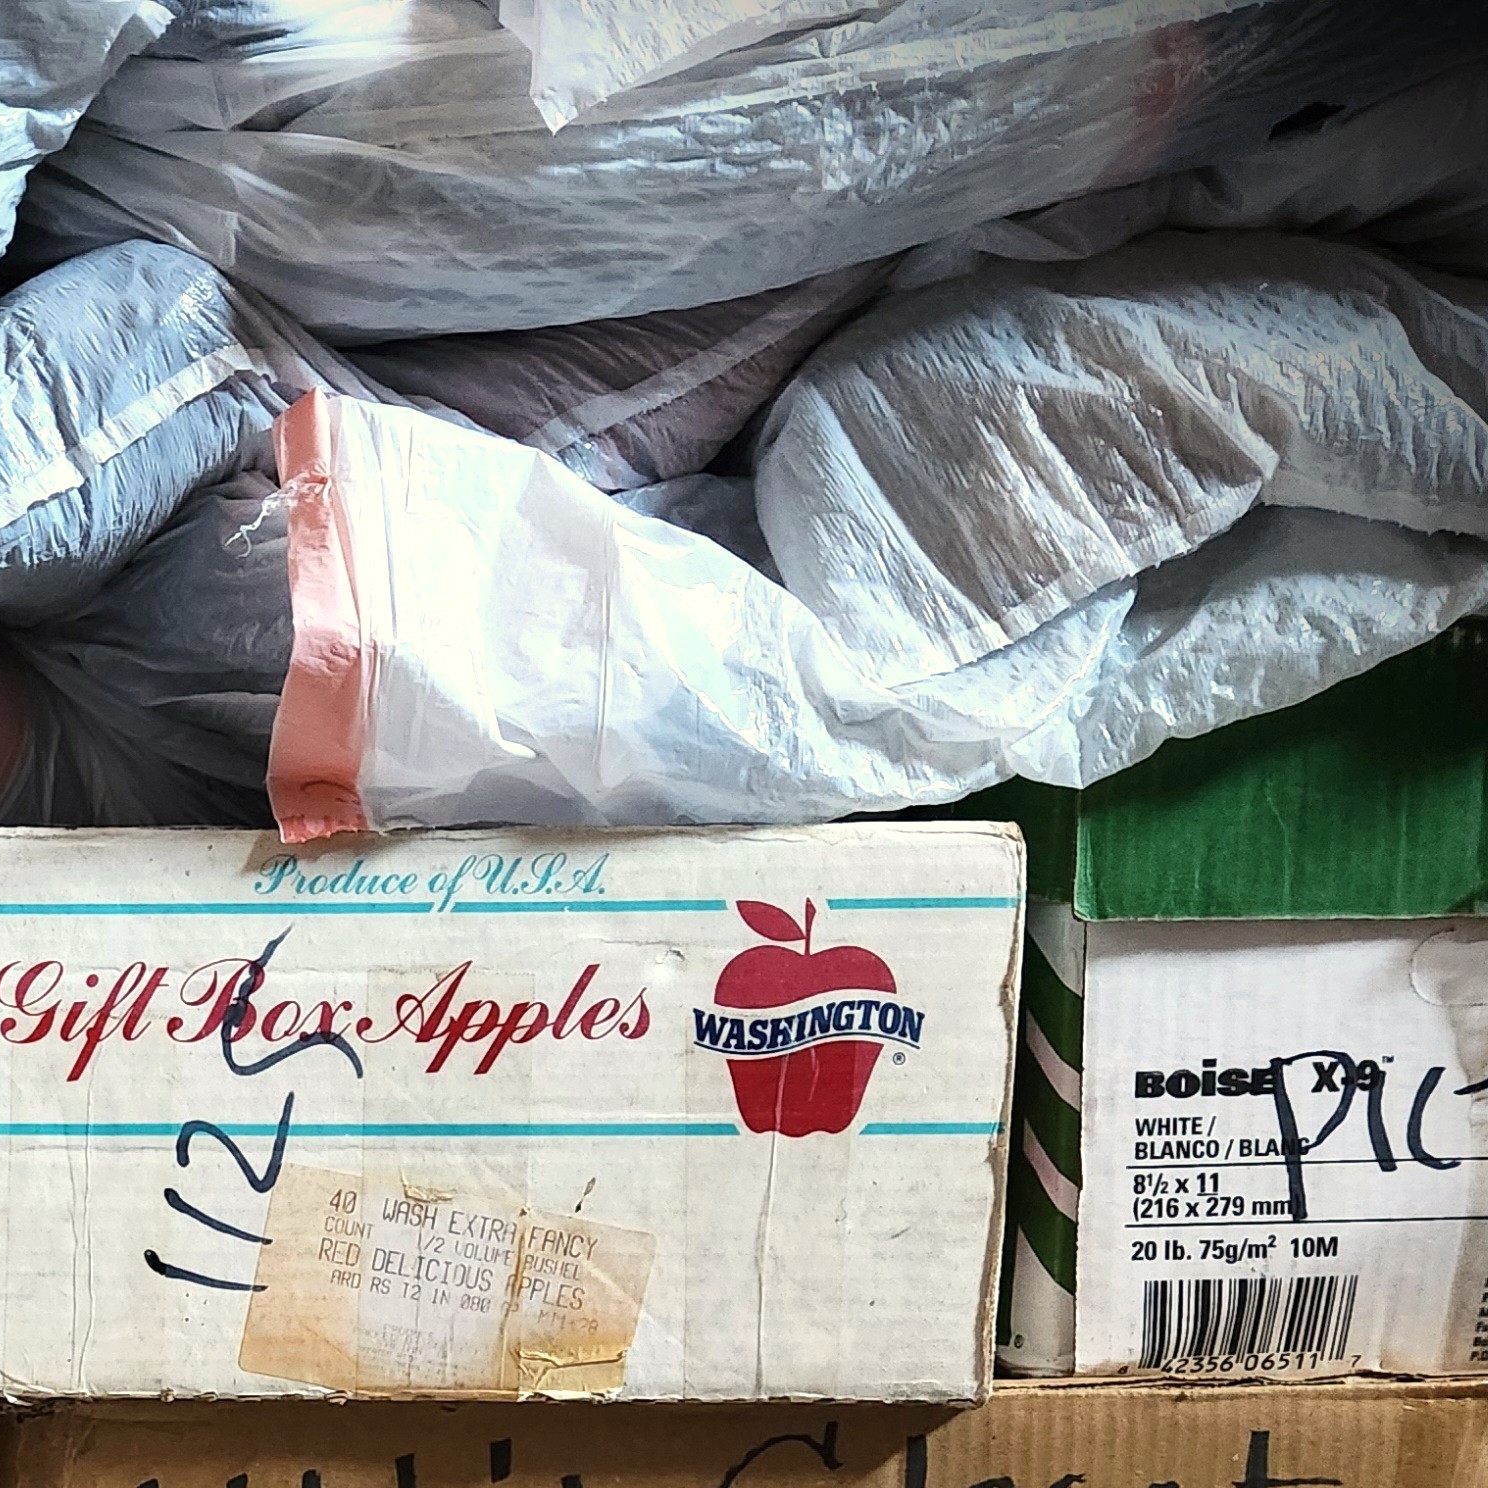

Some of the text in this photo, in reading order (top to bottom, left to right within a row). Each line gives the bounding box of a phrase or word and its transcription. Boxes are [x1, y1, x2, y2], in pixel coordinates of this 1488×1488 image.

[254, 854, 606, 913] Produce of U.S.A.
[167, 957, 354, 1044] Box
[358, 960, 651, 1075] Apples
[692, 1000, 926, 1051] WASHINGTON
[1135, 1139, 1219, 1160] BLANCO
[329, 1188, 599, 1261] 40 WASH EXTRA FANCY
[1133, 1197, 1179, 1221] (216
[1205, 1196, 1245, 1217] 279
[318, 1237, 586, 1311] RED DELICIOUS APPLES
[324, 1215, 375, 1239] COUNT
[524, 1254, 581, 1281] BUSHEL
[1131, 1241, 1157, 1262] 20
[1165, 1240, 1193, 1261] lb.
[1290, 1236, 1339, 1258] 10M
[1244, 1353, 1320, 1371] 06511
[1350, 1354, 1362, 1368] 7
